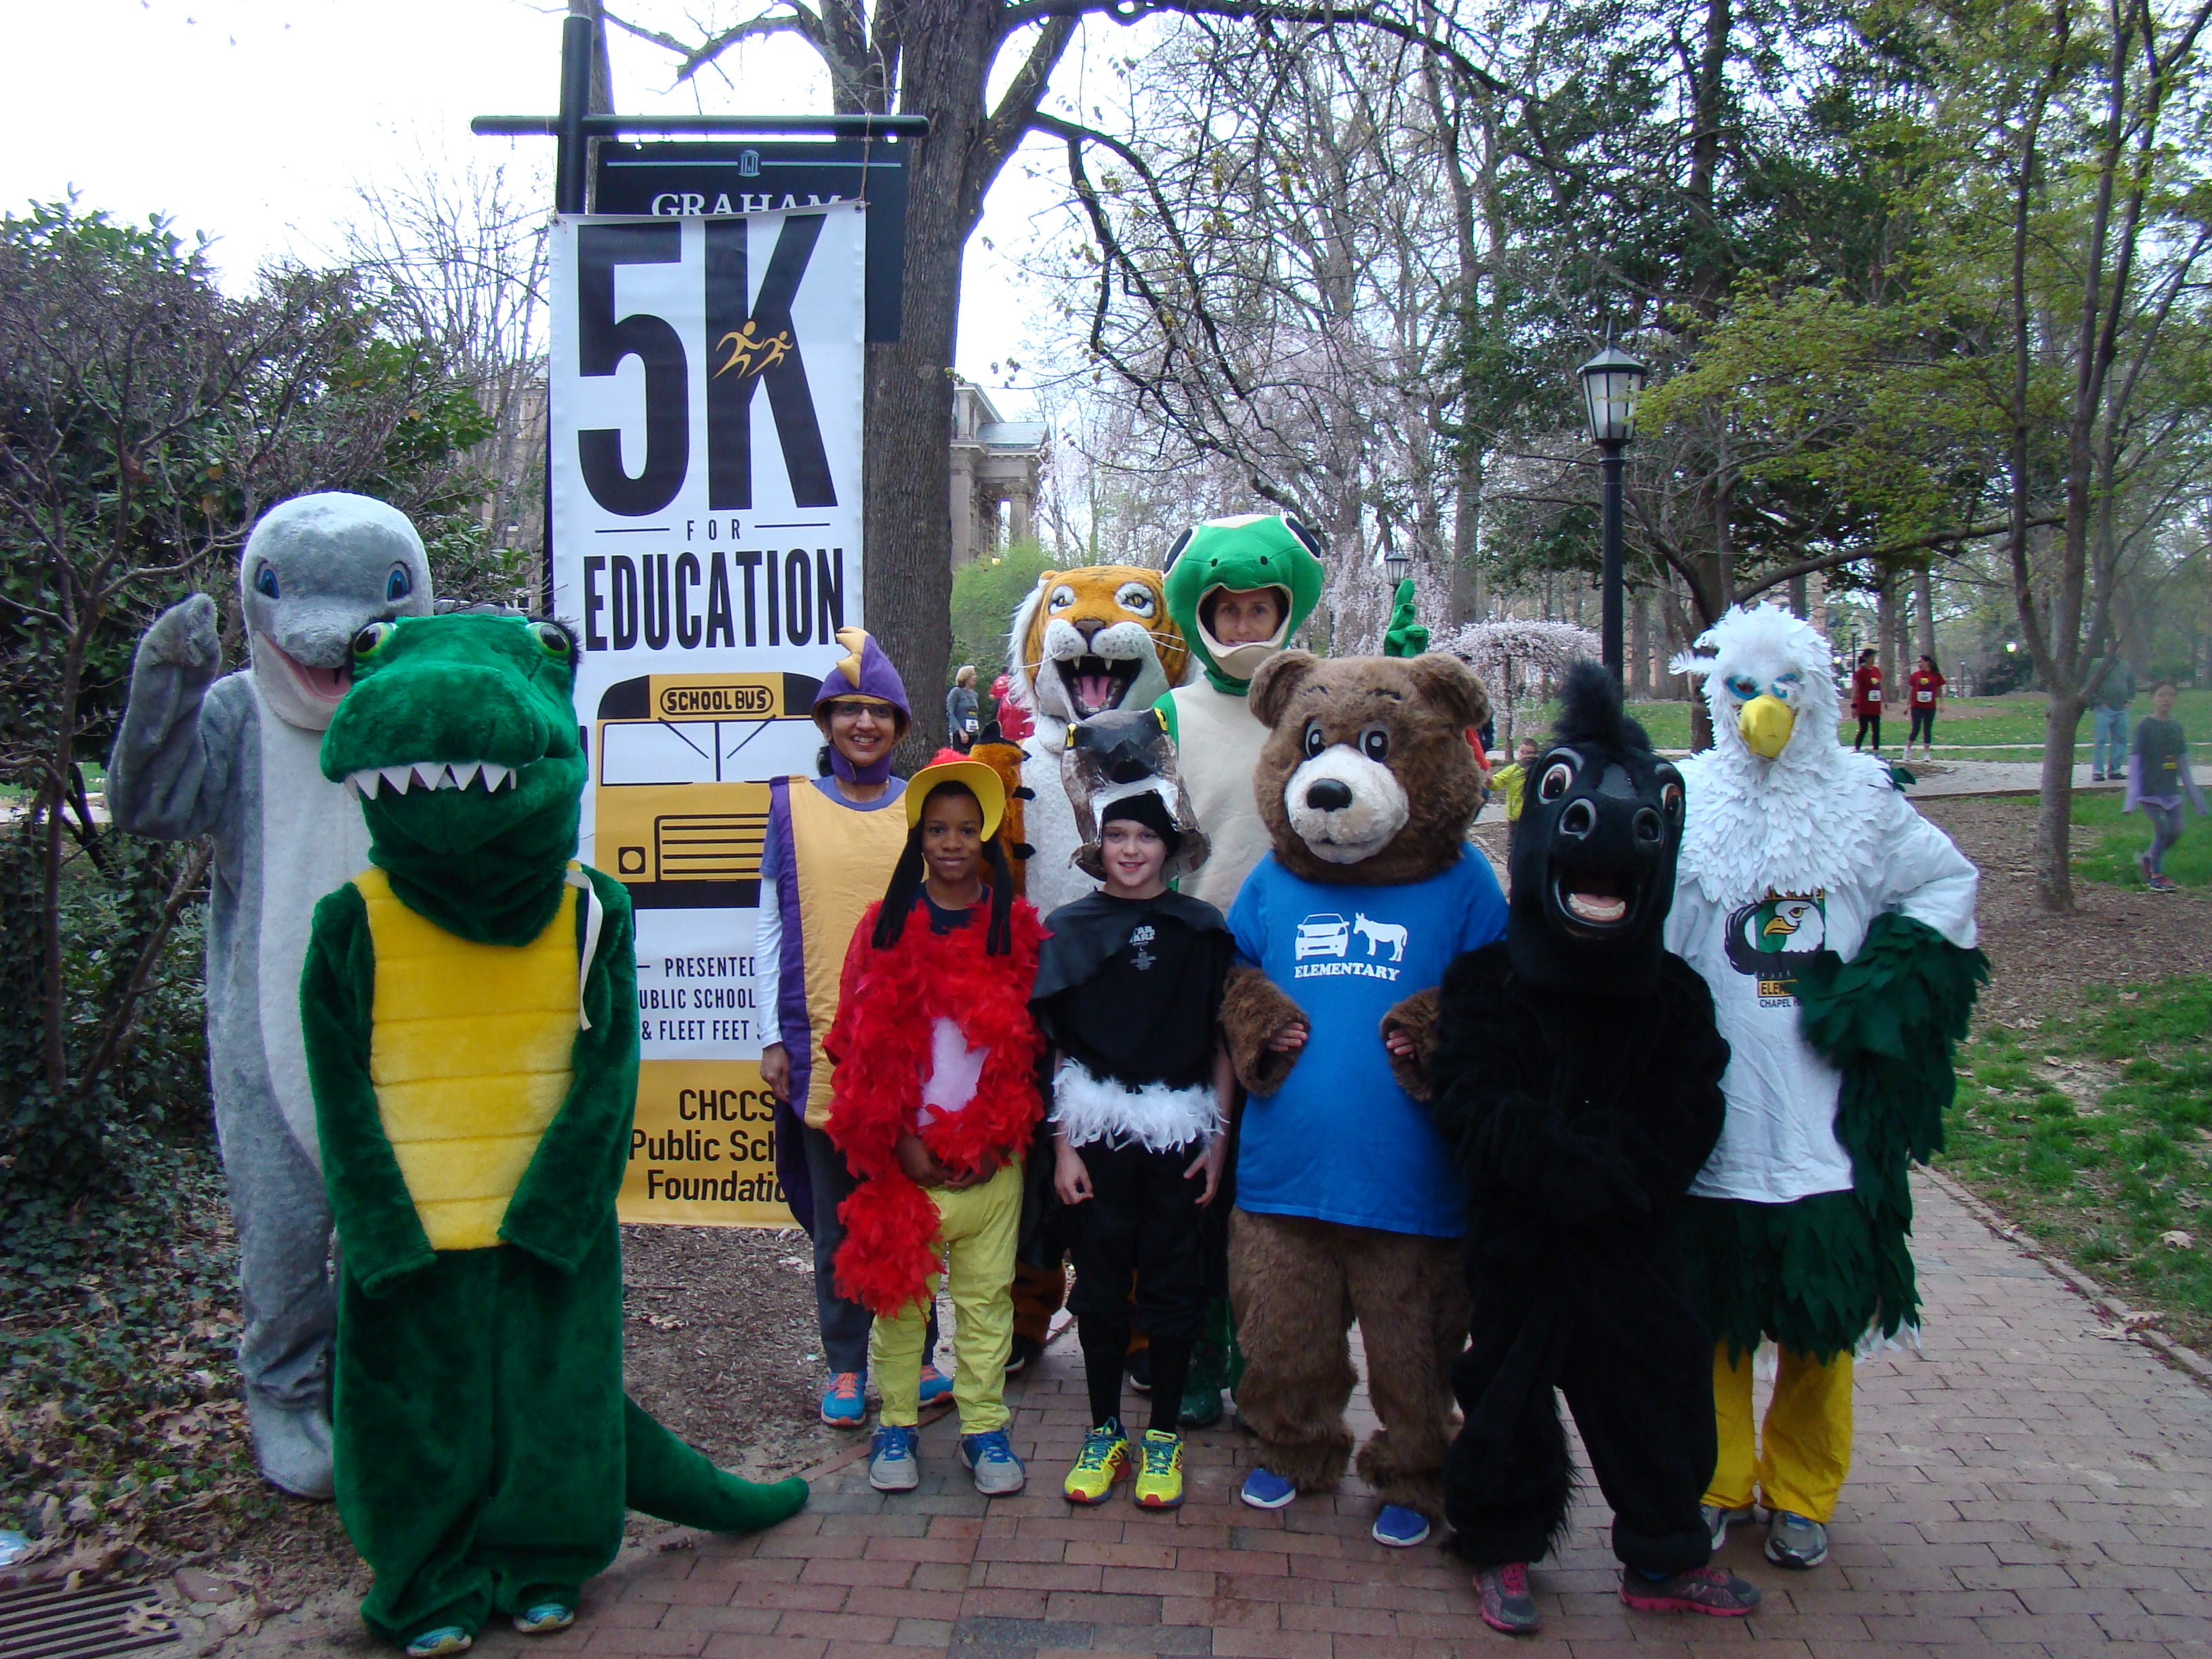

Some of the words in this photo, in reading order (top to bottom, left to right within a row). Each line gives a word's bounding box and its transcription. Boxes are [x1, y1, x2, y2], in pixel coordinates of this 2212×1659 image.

[577, 213, 838, 517] 5K
[687, 518, 740, 541] FOR
[583, 548, 844, 651] EDUCATION
[667, 691, 733, 711] SCHOOL
[735, 690, 766, 710] BUS
[1294, 962, 1401, 981] ELEMENTARY
[639, 989, 687, 1009] UBLIC
[1759, 999, 1791, 1008] CHAPEL
[642, 1021, 652, 1040] &
[659, 1020, 705, 1040] FLEET
[713, 1020, 750, 1040] FEET
[680, 1089, 776, 1122] CHCCS
[629, 1129, 720, 1162] Public
[647, 1169, 790, 1203] Foundatio
